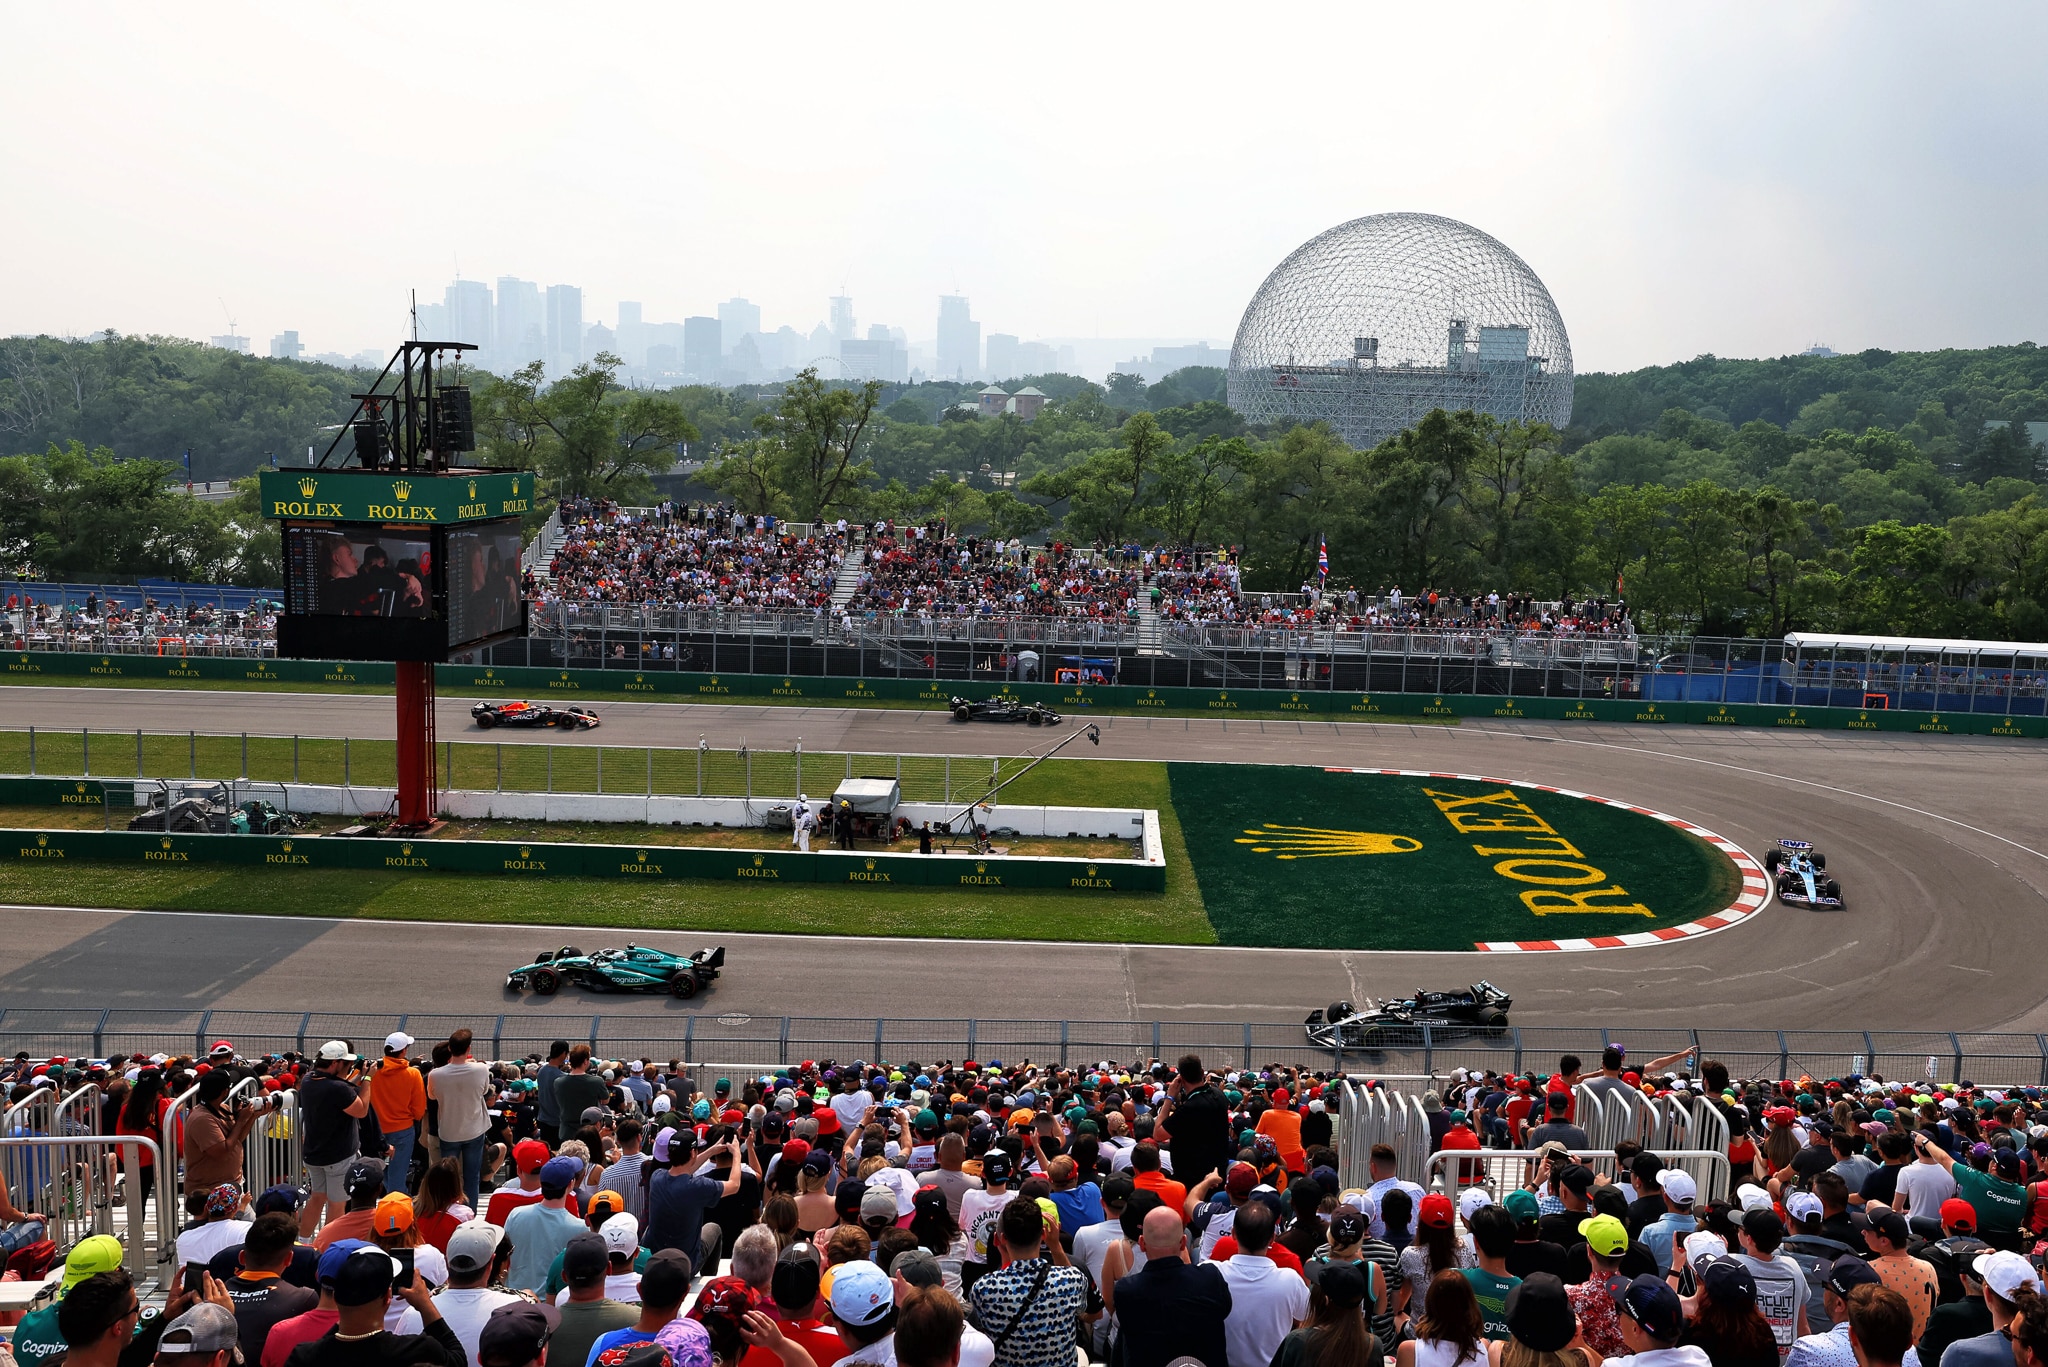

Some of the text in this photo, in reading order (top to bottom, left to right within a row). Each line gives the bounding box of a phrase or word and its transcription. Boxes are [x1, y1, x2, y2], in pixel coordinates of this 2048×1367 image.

[275, 502, 343, 516] ROLEX
[503, 500, 527, 512] ROLEX
[369, 505, 436, 520] ROLEX
[459, 504, 486, 518] ROLEX
[9, 664, 41, 672] ROLEX
[1209, 701, 1238, 709] ROLEX
[1920, 724, 1949, 732] ROLEX
[62, 795, 101, 803] ROLEX
[21, 849, 64, 857] ROLEX
[146, 852, 188, 860] ROLEX
[1422, 787, 1656, 919] ROLEX
[267, 855, 308, 863] ROLEX
[386, 857, 428, 866] ROLEX
[505, 861, 545, 870] ROLEX
[622, 864, 662, 873] ROLEX
[738, 868, 778, 877] ROLEX
[850, 872, 889, 881] ROLEX
[961, 876, 1000, 884] ROLEX
[1072, 878, 1111, 887] ROLEX
[1986, 1190, 2021, 1206] Cognizant
[970, 1210, 1001, 1239] ENCHANT
[1756, 1295, 1793, 1307] RCUIT
[22, 1339, 69, 1358] Cogniz
